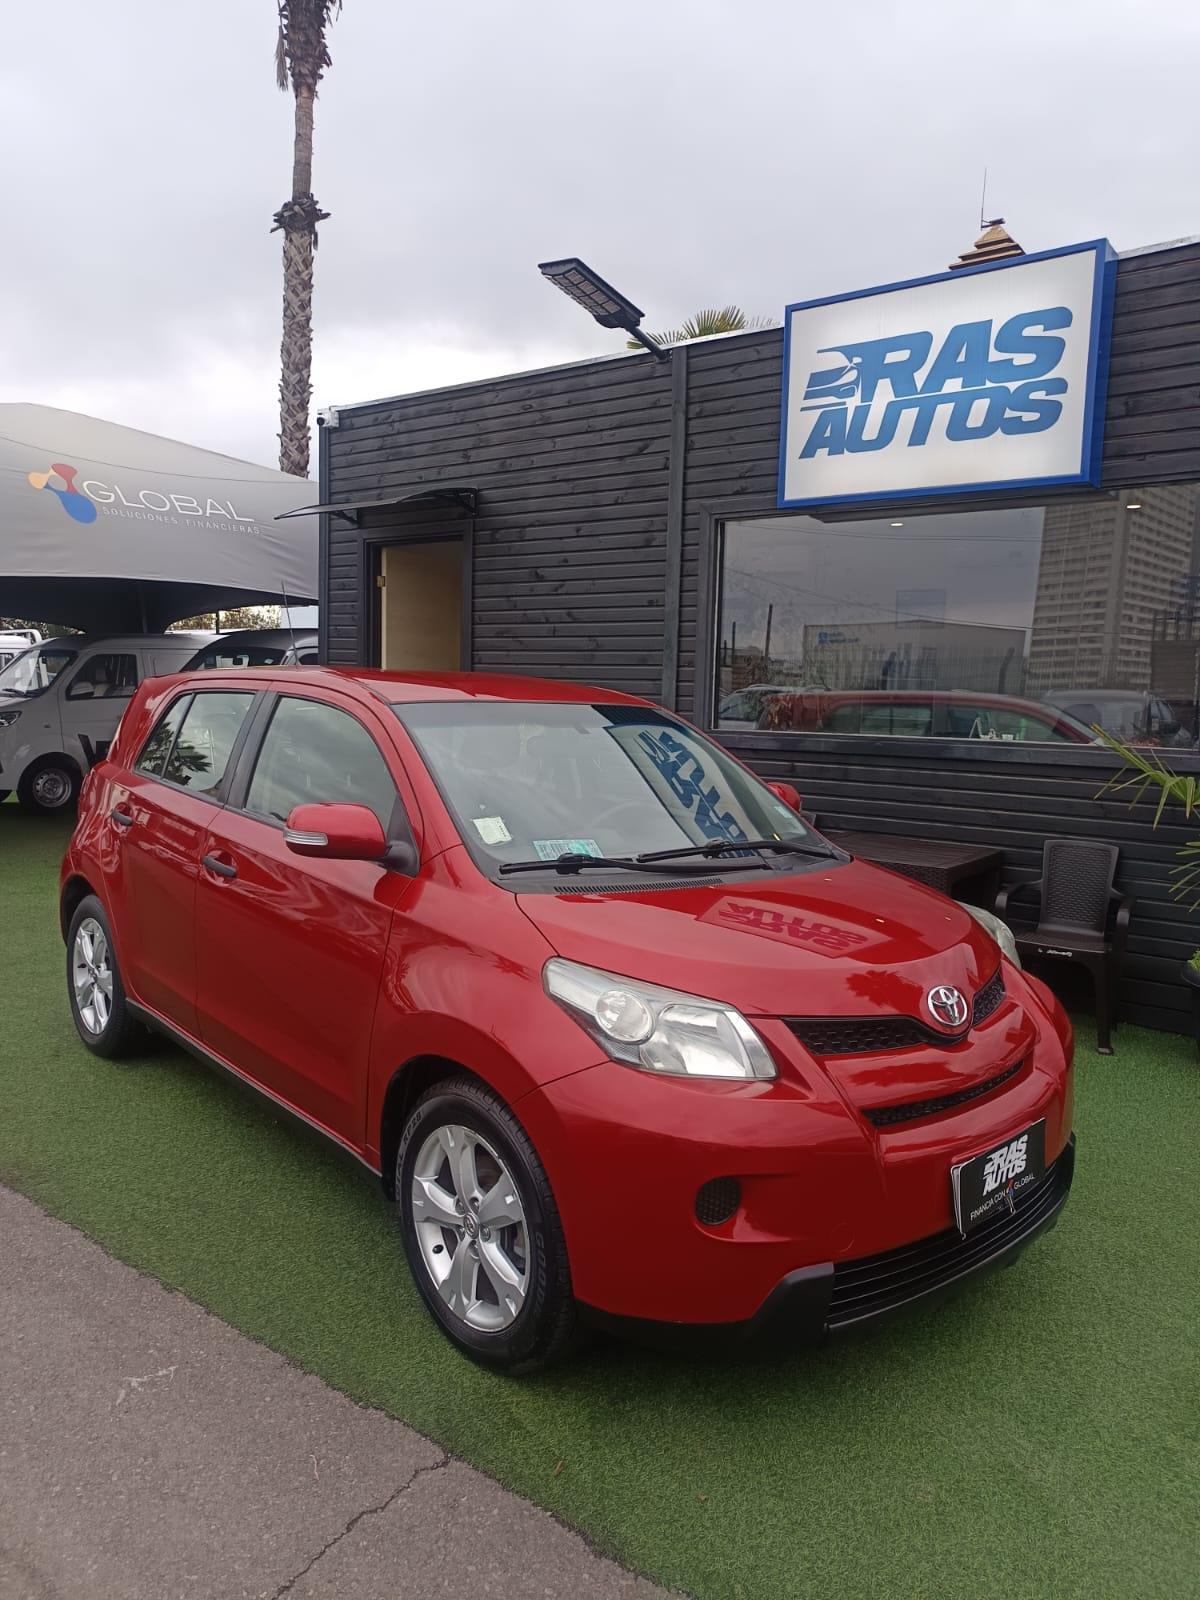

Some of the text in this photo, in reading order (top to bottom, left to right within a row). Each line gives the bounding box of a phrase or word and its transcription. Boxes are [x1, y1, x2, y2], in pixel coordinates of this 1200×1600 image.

[808, 306, 1073, 402] RAS
[798, 377, 1068, 460] AUTOS
[82, 480, 255, 522] GLOBAL
[102, 506, 260, 535] SOLUCIONES FINANCIERAS
[984, 1134, 1028, 1173] RAS
[982, 1153, 1027, 1197] AUTOS
[1013, 1173, 1035, 1190] GLOBAL
